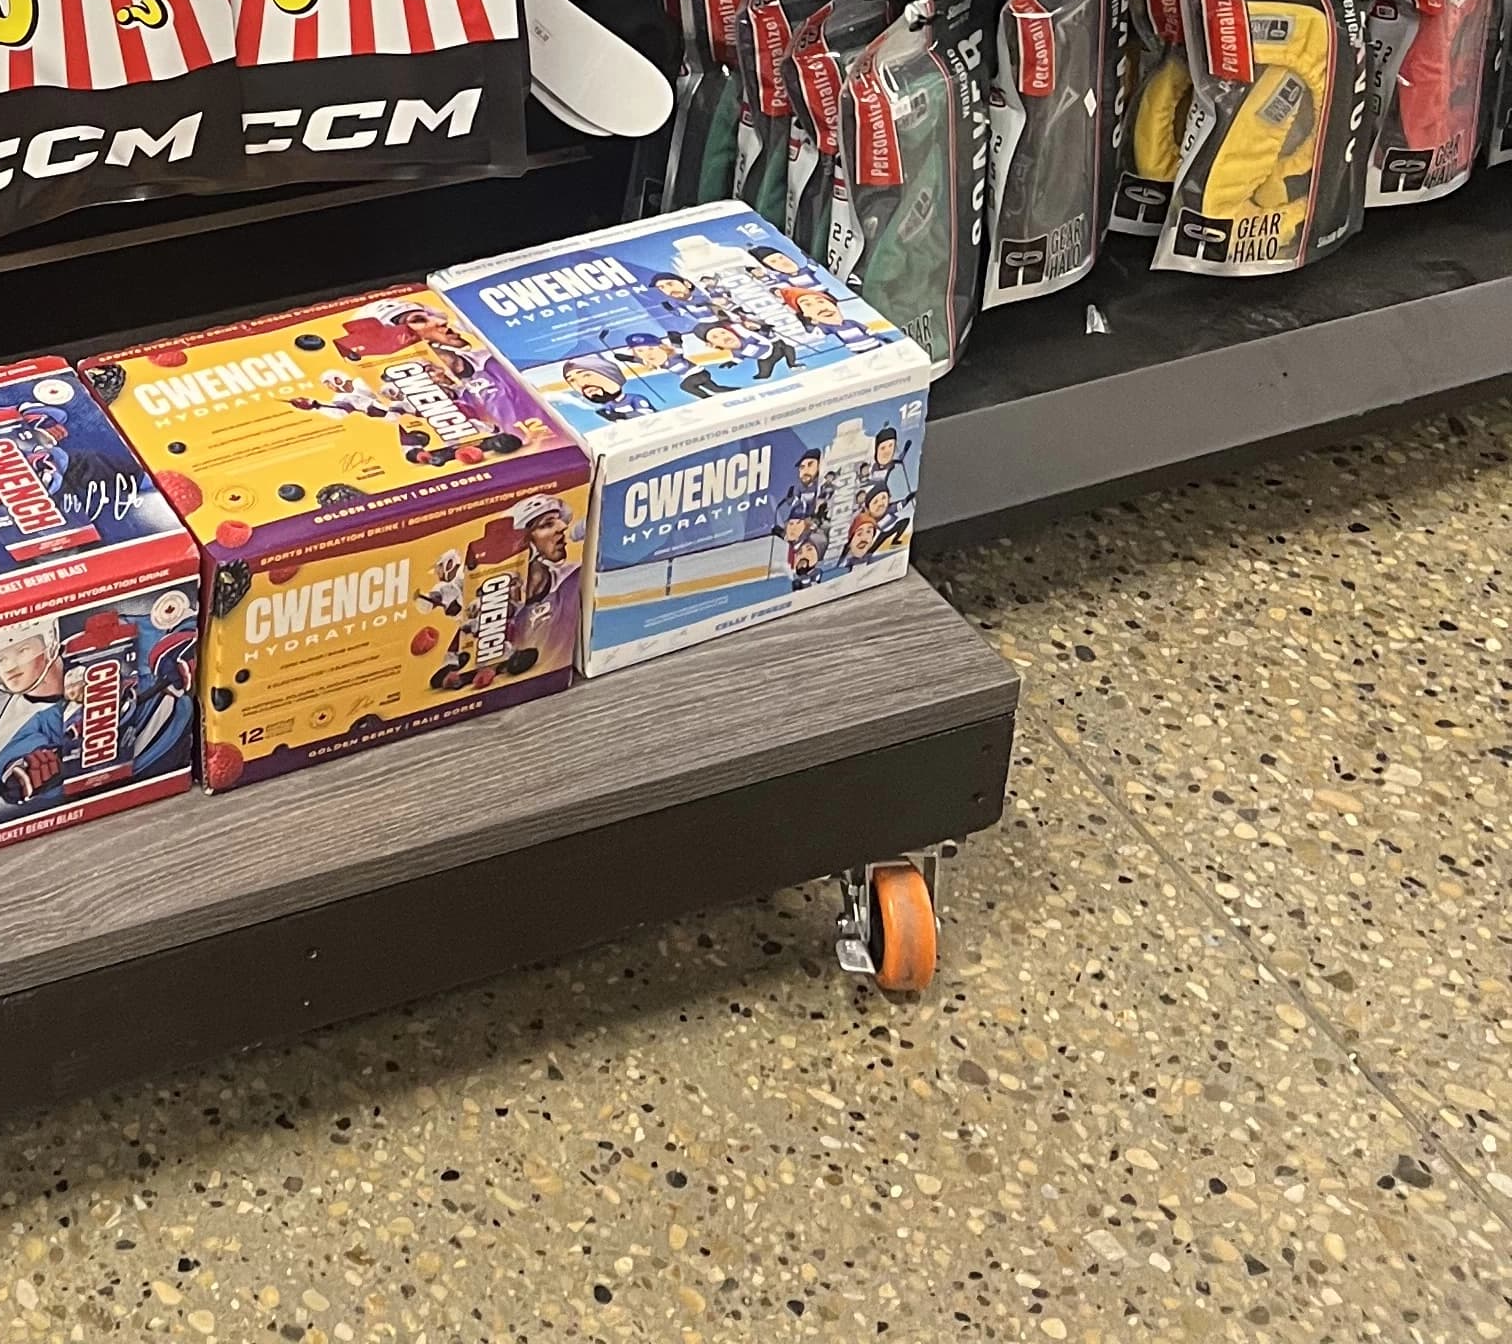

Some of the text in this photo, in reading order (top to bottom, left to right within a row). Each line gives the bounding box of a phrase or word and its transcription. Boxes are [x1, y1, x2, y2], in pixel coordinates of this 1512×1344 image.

[241, 88, 482, 156] CCM
[1233, 237, 1279, 263] HALO
[1237, 213, 1282, 239] GEAR
[479, 256, 636, 320] CWENCH
[505, 283, 649, 329] HYDRATION
[133, 351, 306, 418] CWENCH
[154, 380, 315, 430] HYDRATION
[387, 362, 478, 442] CWENCH
[623, 444, 773, 530] CWENCH
[622, 493, 769, 547] HYDRATION
[34, 591, 77, 614] SPORTS
[77, 577, 138, 604] HYDRATION
[138, 568, 171, 585] DRINK
[244, 558, 412, 646] CWENCH
[243, 609, 408, 664] HYDRATION
[475, 573, 513, 665] CWENCH
[81, 659, 122, 770] CWENCH
[239, 727, 265, 746] 12
[27, 817, 56, 837] BERRY
[55, 808, 85, 829] BLAST
